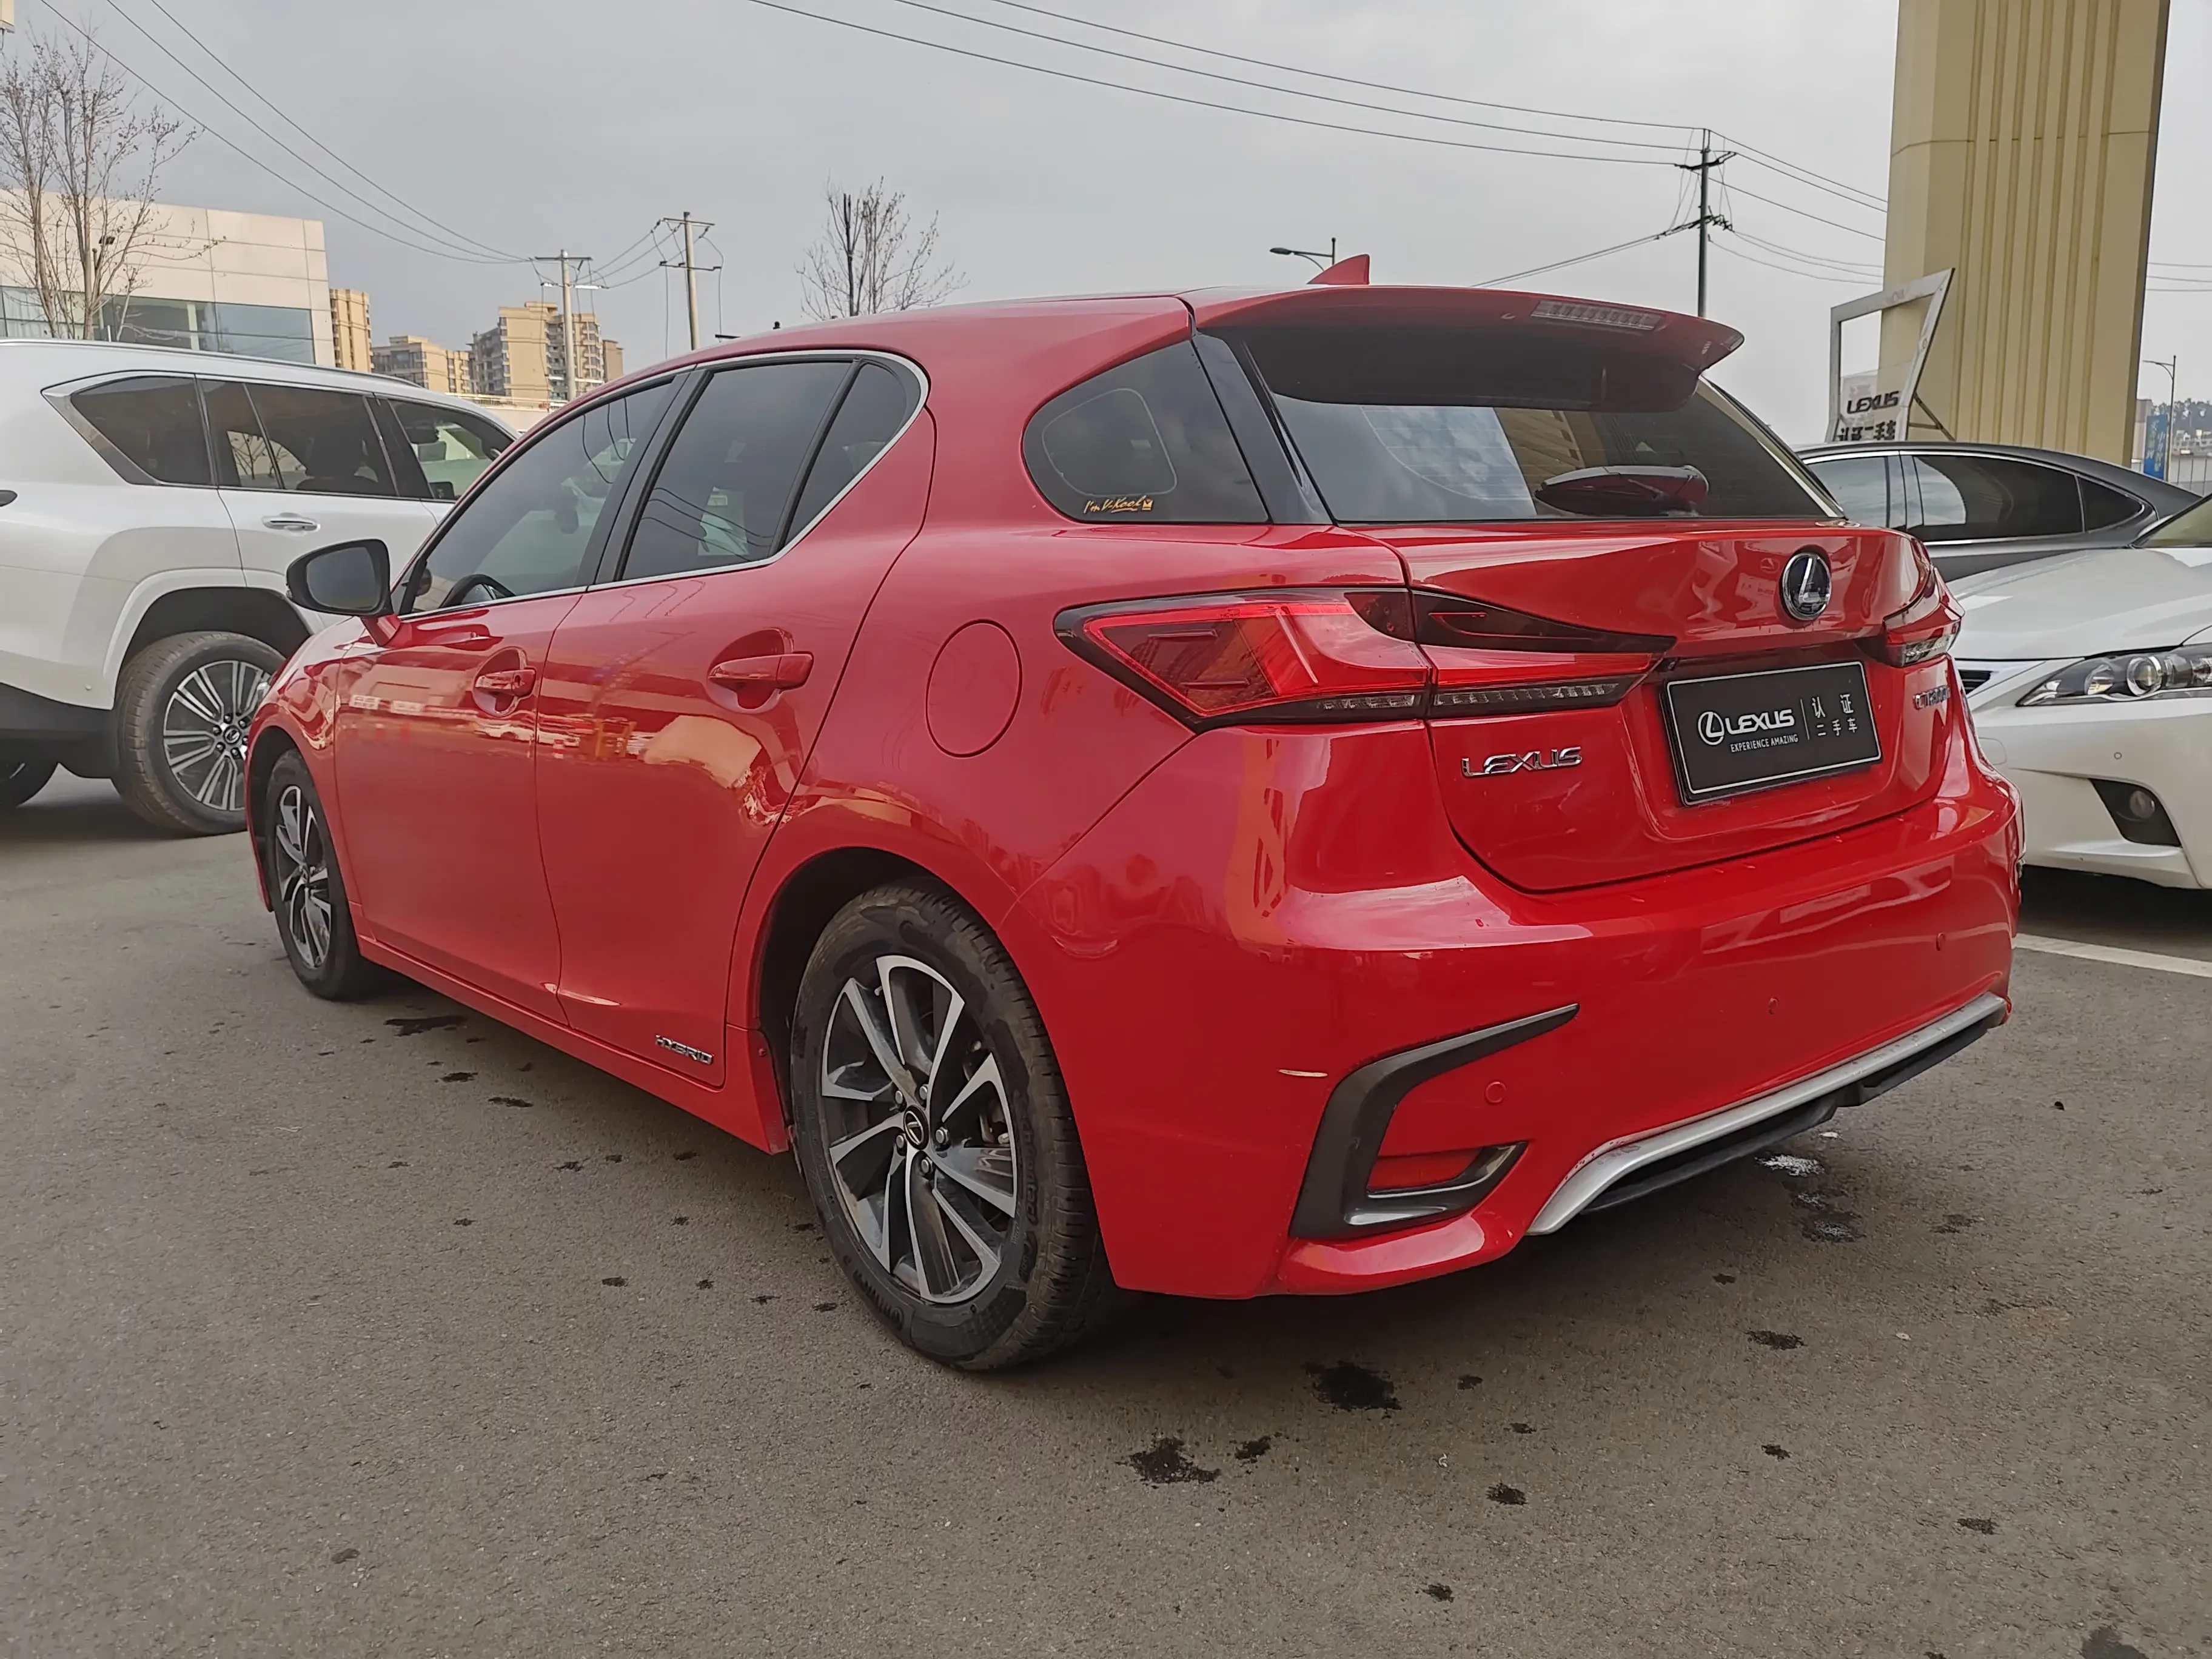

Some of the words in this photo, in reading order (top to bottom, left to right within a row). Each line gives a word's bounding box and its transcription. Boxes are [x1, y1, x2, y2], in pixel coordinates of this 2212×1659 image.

[1846, 390, 1900, 414] LEXUS
[1812, 694, 1854, 719] 认证
[1726, 709, 1795, 735] LEXUS
[1817, 717, 1858, 737] 二手车
[1730, 738, 1770, 752] EXPERIENCE
[1771, 734, 1798, 747] AMAZING
[1461, 746, 1583, 777] LEXUS
